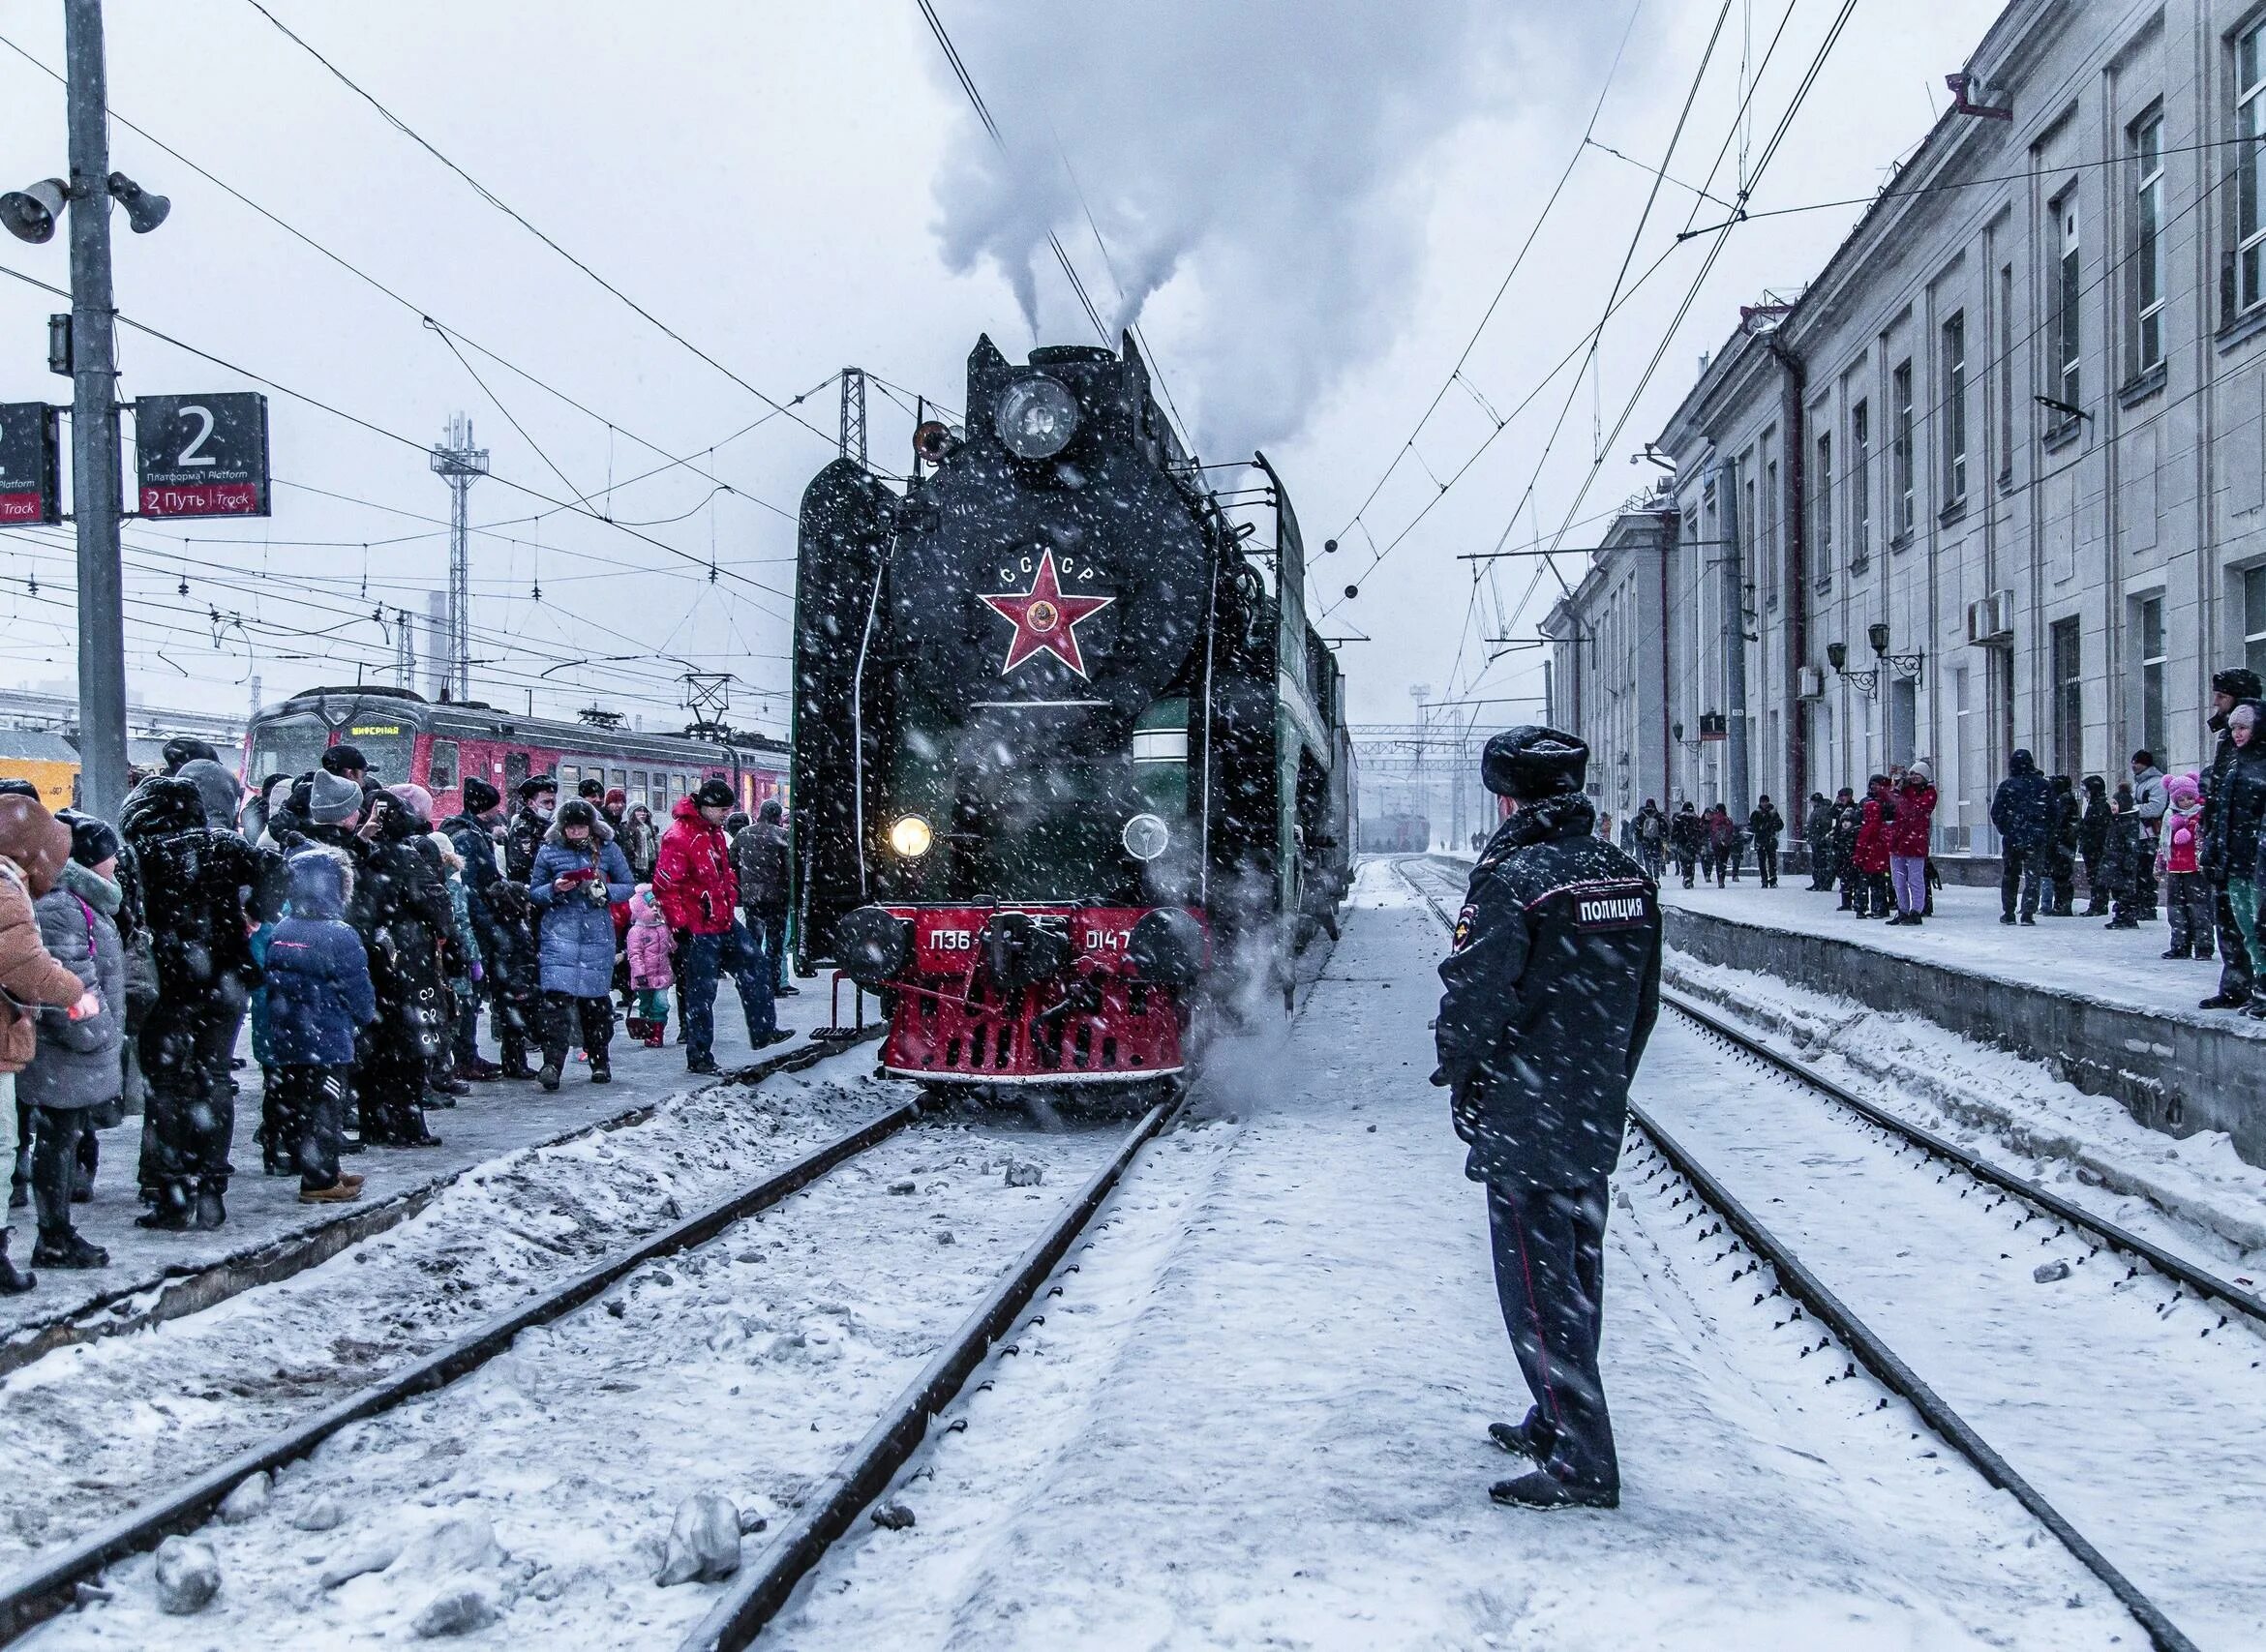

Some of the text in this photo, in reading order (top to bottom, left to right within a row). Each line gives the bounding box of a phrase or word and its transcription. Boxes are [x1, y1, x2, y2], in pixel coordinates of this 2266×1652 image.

[178, 405, 216, 466] 2
[147, 470, 248, 482] Платформа Platform
[4, 502, 35, 514] Track
[148, 491, 249, 510] 2 Путь Track
[1000, 556, 1094, 583] СССР
[1709, 717, 1715, 731] 1
[1580, 898, 1644, 921] ПОЛИЦИЯ
[1086, 930, 1131, 949] 0147
